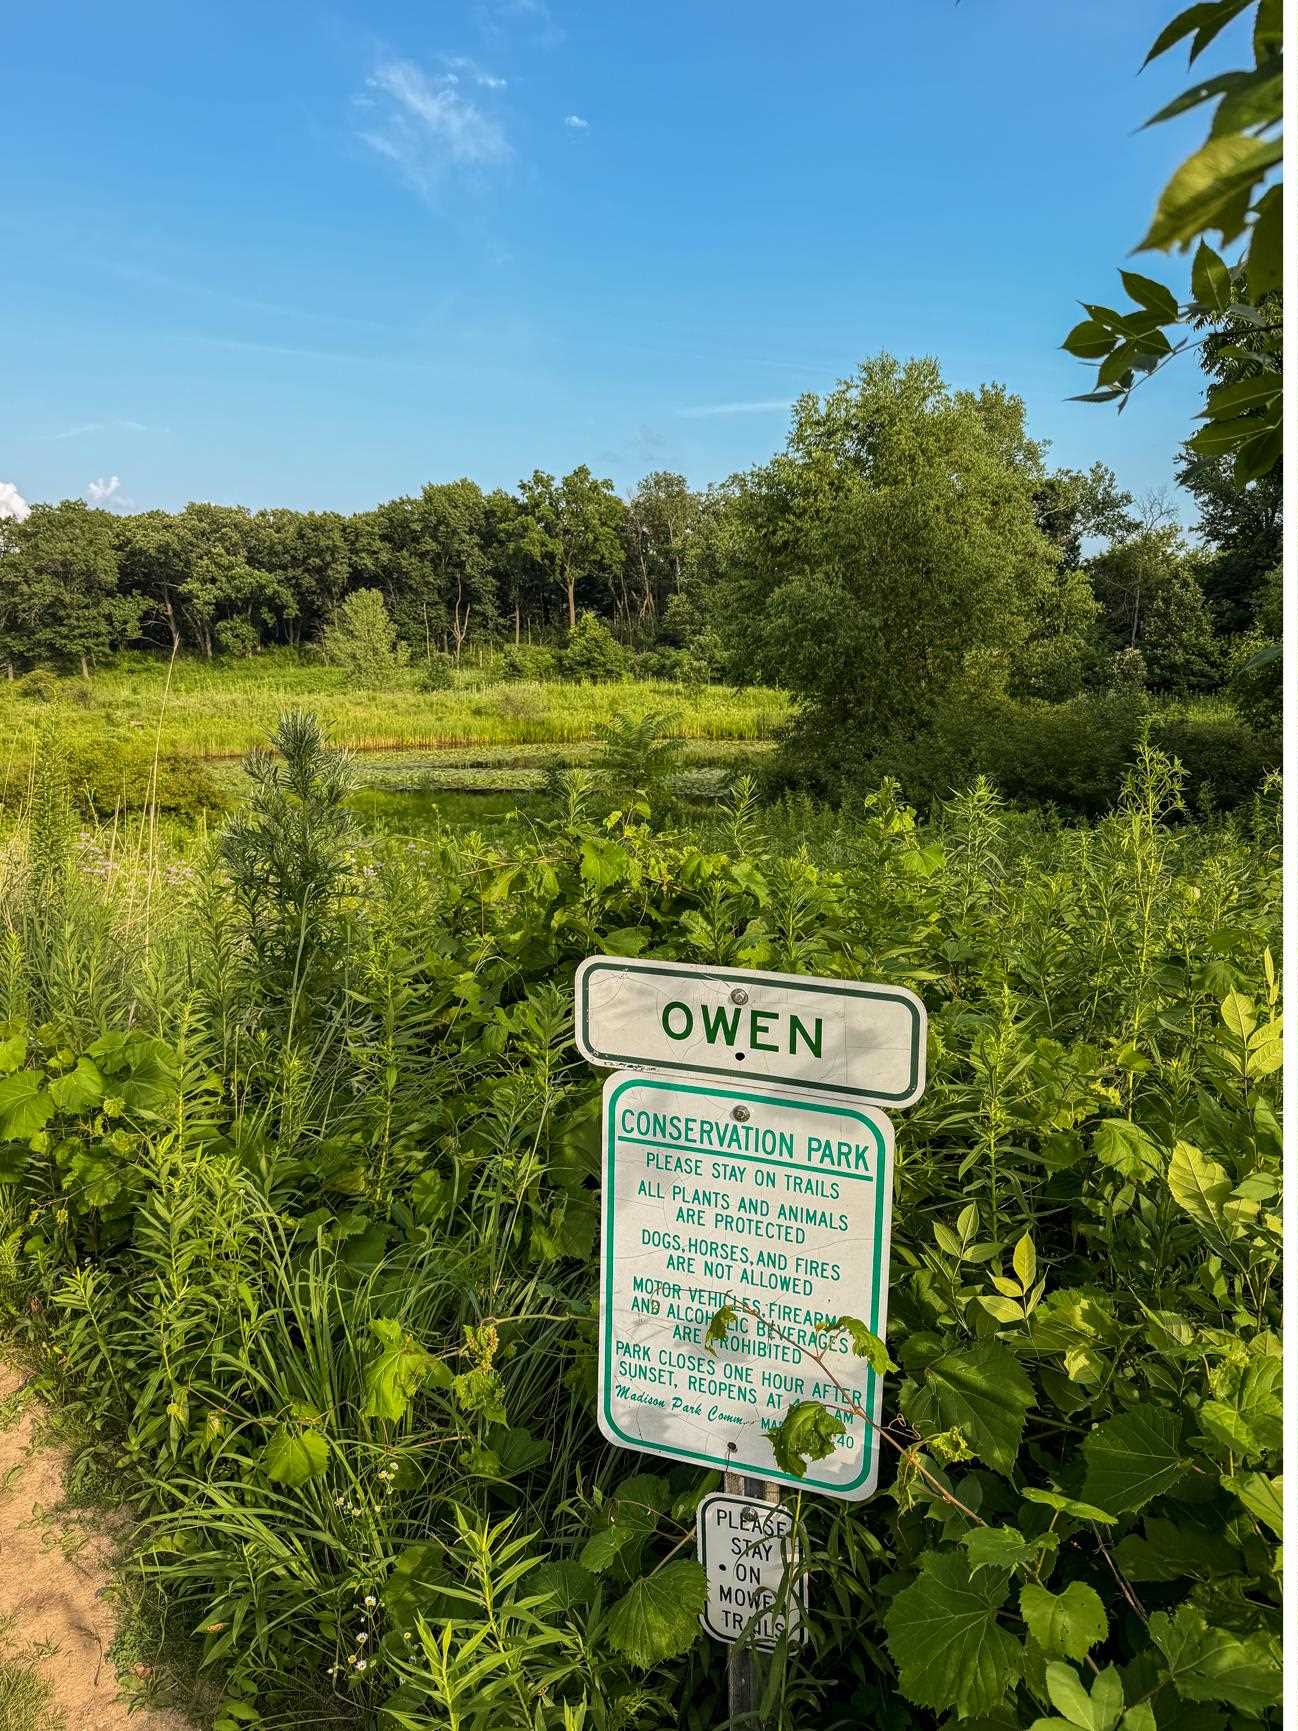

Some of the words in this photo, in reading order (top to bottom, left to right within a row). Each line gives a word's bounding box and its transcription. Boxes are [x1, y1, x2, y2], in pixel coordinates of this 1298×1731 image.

[662, 1001, 823, 1059] OWEN
[621, 1109, 794, 1158] CONSERVATION
[807, 1136, 870, 1172] PARK
[646, 1152, 703, 1176] PLEASE
[712, 1163, 746, 1183] STAY
[754, 1170, 776, 1188] ON
[784, 1174, 840, 1199] TRAILS
[638, 1180, 665, 1199] ALL
[672, 1185, 730, 1209] PLANTS
[737, 1197, 769, 1217] AND
[777, 1203, 848, 1231] ANIMALS
[676, 1207, 706, 1226] ARE
[714, 1214, 806, 1244] PROTECTED
[667, 1254, 696, 1274] ARE
[703, 1263, 733, 1281] NOT
[740, 1268, 813, 1296] ALLOWED
[757, 1251, 788, 1271] AND
[795, 1258, 841, 1281] FIRES
[633, 1276, 681, 1299] MOTOR
[769, 1303, 837, 1329] FIREARM
[631, 1296, 660, 1315] AND
[666, 1303, 749, 1334] ALCOHLIC
[757, 1320, 848, 1354] BEVERAGES
[672, 1324, 702, 1344] ARE
[615, 1340, 651, 1361] PARK
[659, 1349, 715, 1375] CLOSES
[723, 1363, 754, 1384] ONE
[762, 1372, 805, 1395] HOUR
[812, 1382, 862, 1406] AFTER
[619, 1360, 679, 1389] SUNSET,
[688, 1375, 757, 1404] REOPENS
[766, 1393, 784, 1410] AT
[615, 1384, 666, 1407] Madison
[671, 1396, 702, 1416] Park
[717, 1509, 787, 1538] PLEASE
[730, 1536, 773, 1562] STAY
[735, 1563, 761, 1585] ON
[719, 1584, 777, 1613] MOWE
[721, 1610, 785, 1638] TRILS
